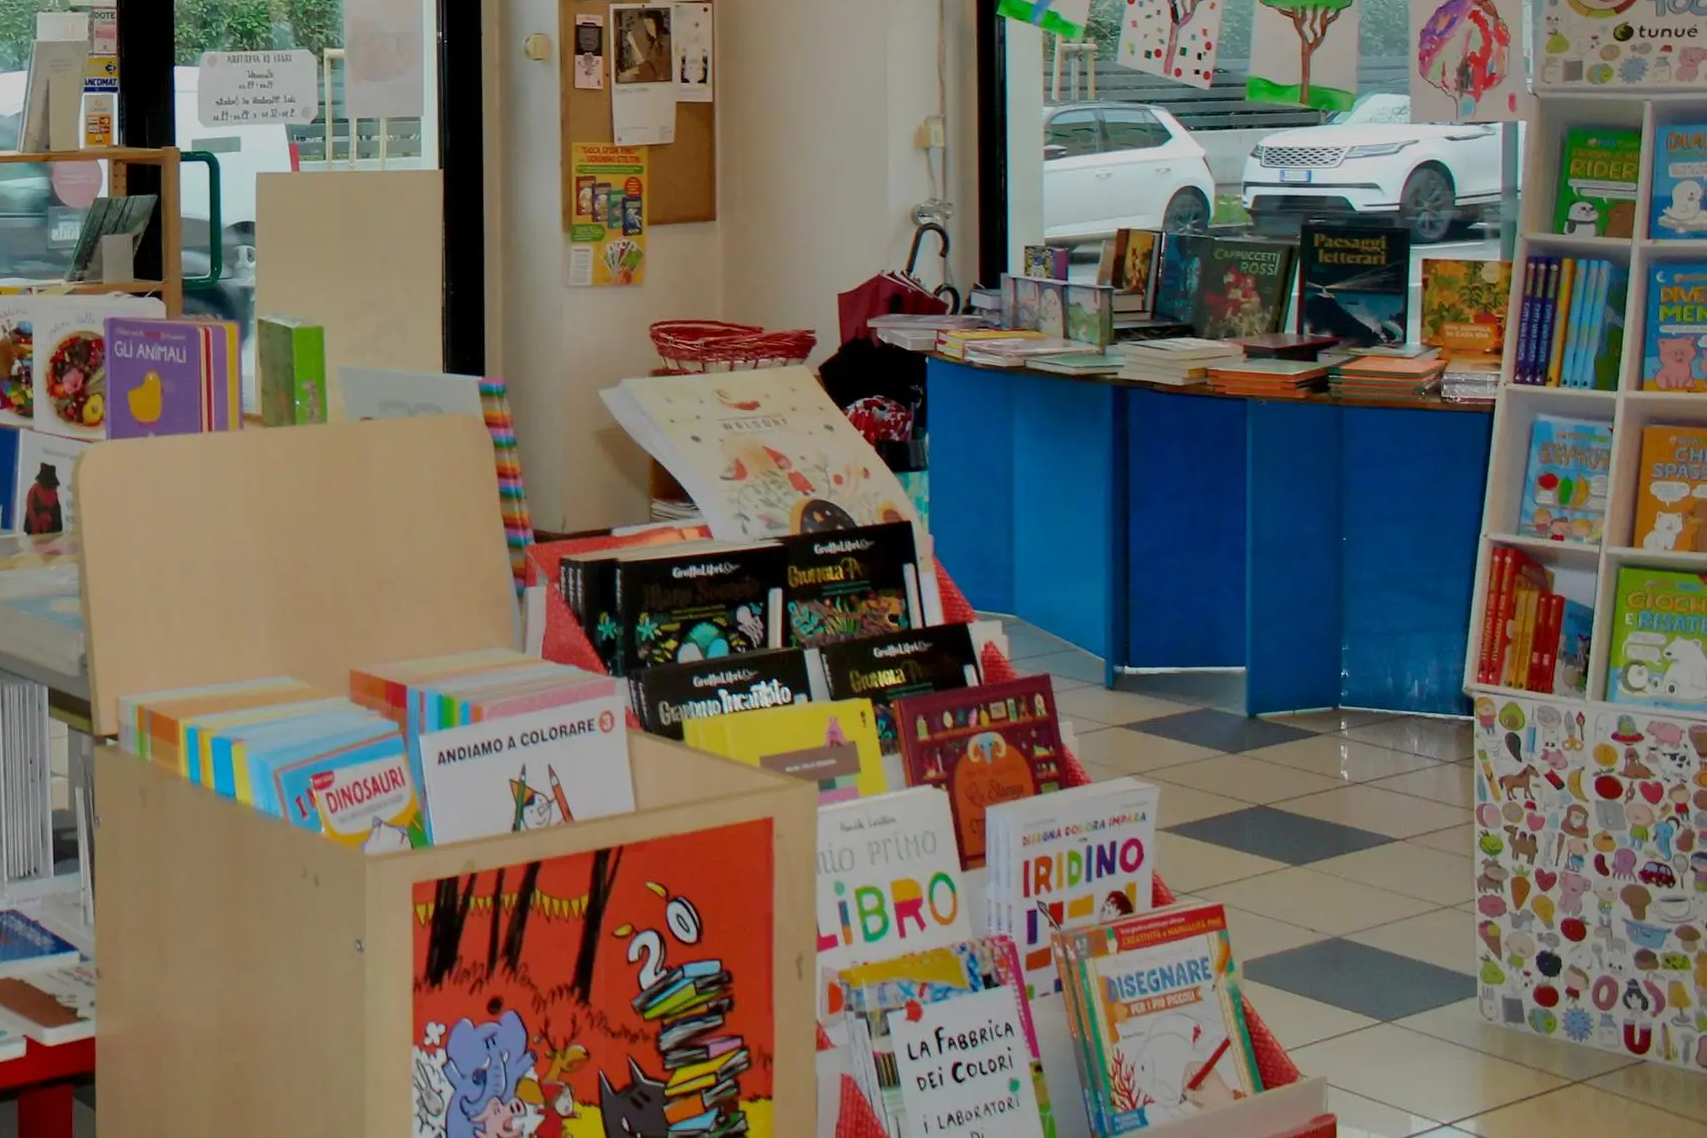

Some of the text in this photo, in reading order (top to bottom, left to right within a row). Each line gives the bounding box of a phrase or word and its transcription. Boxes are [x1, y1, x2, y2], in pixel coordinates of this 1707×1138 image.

[1639, 24, 1699, 39] tunué
[84, 78, 118, 88] ANCOMAT
[1314, 232, 1386, 253] Paesaggi
[1319, 248, 1386, 264] letterari
[115, 340, 186, 363] GLI ANIMALI
[1674, 447, 1707, 462] CH
[437, 739, 503, 766] ANDIAMO
[507, 736, 516, 750] A
[519, 717, 596, 747] COLORARE
[326, 766, 406, 815] DINOSAURI
[1022, 837, 1144, 899] IRIDINO
[1107, 956, 1213, 1003] DISEGNARE
[907, 1019, 1015, 1061] LA FABBRICA
[916, 1046, 1014, 1092] DEI COLORI
[937, 1095, 1022, 1130] LABORATORI
